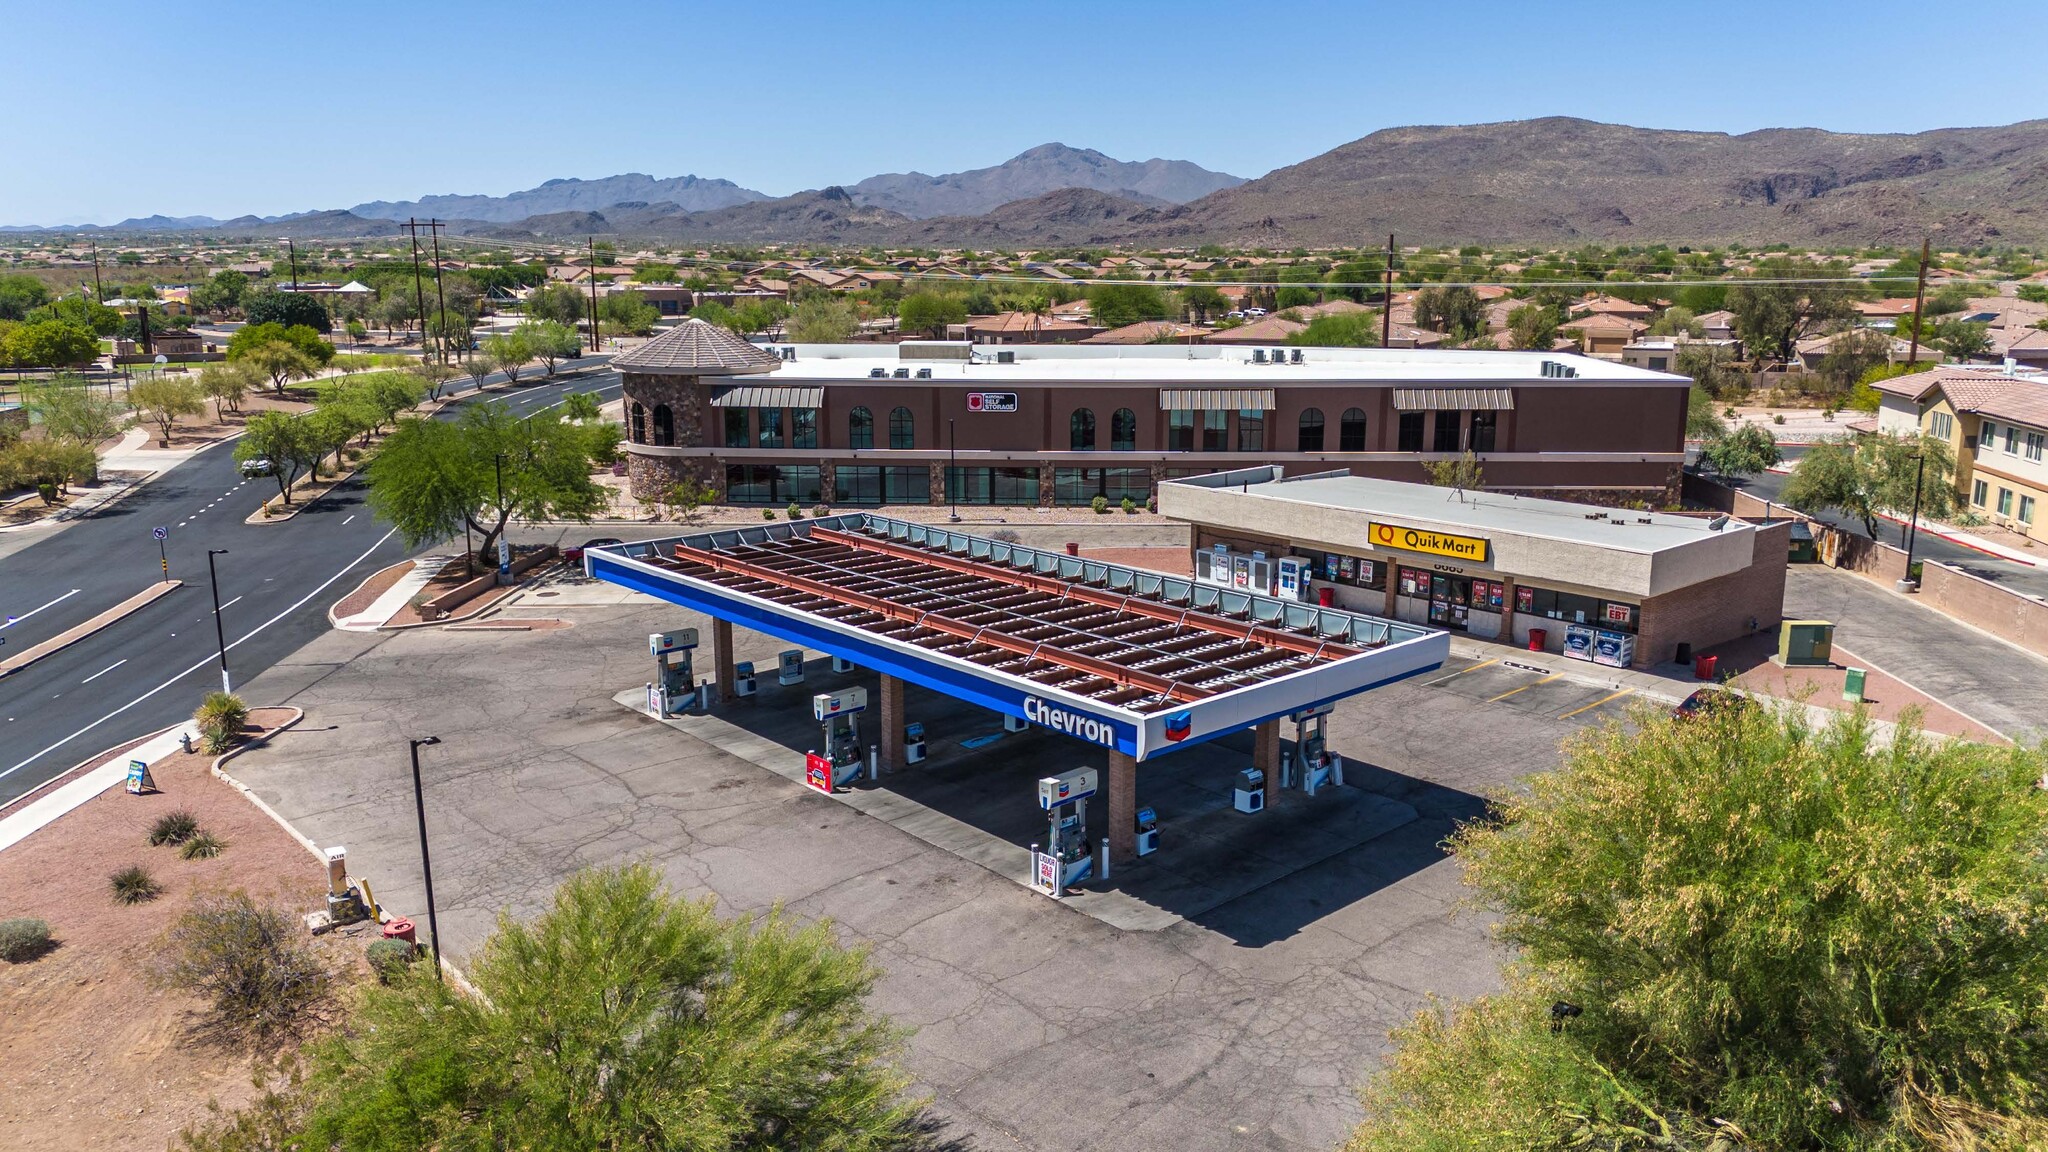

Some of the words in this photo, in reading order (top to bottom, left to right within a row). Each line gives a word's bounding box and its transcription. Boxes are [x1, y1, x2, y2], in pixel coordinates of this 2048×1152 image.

[1378, 524, 1394, 545] Q
[1405, 531, 1440, 549] Quik
[1442, 538, 1476, 555] Mart
[1609, 609, 1627, 620] EBT
[683, 633, 690, 641] 11
[850, 694, 855, 702] 7
[1023, 695, 1114, 747] Chevron
[1080, 777, 1086, 786] 3
[1040, 854, 1055, 867] LIQUOR
